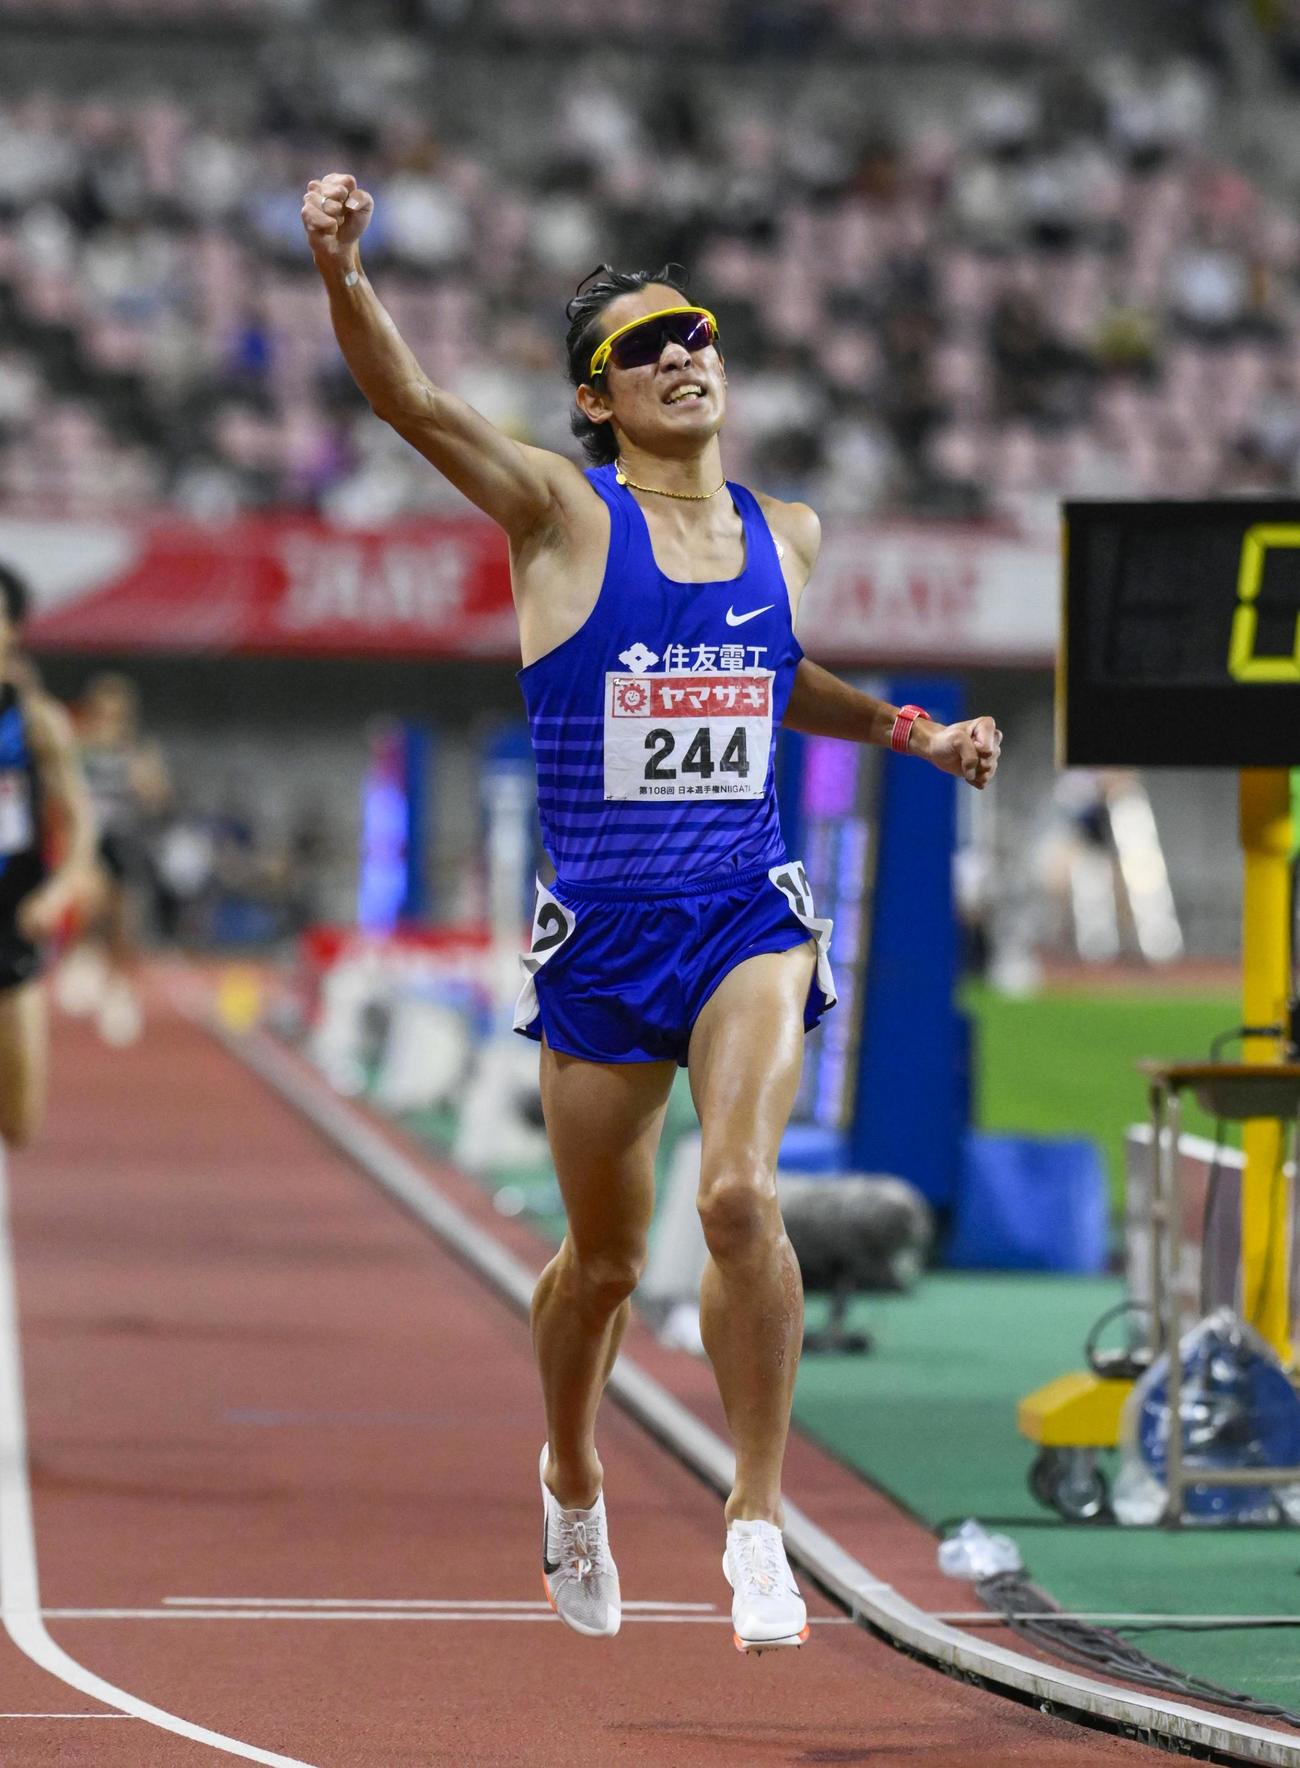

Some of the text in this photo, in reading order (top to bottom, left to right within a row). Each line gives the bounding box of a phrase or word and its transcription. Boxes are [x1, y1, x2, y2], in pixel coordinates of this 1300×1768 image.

[662, 643, 768, 673] 住友電工
[658, 685, 765, 710] ヤマザキ
[643, 726, 750, 780] 244
[639, 785, 675, 795] 第108回
